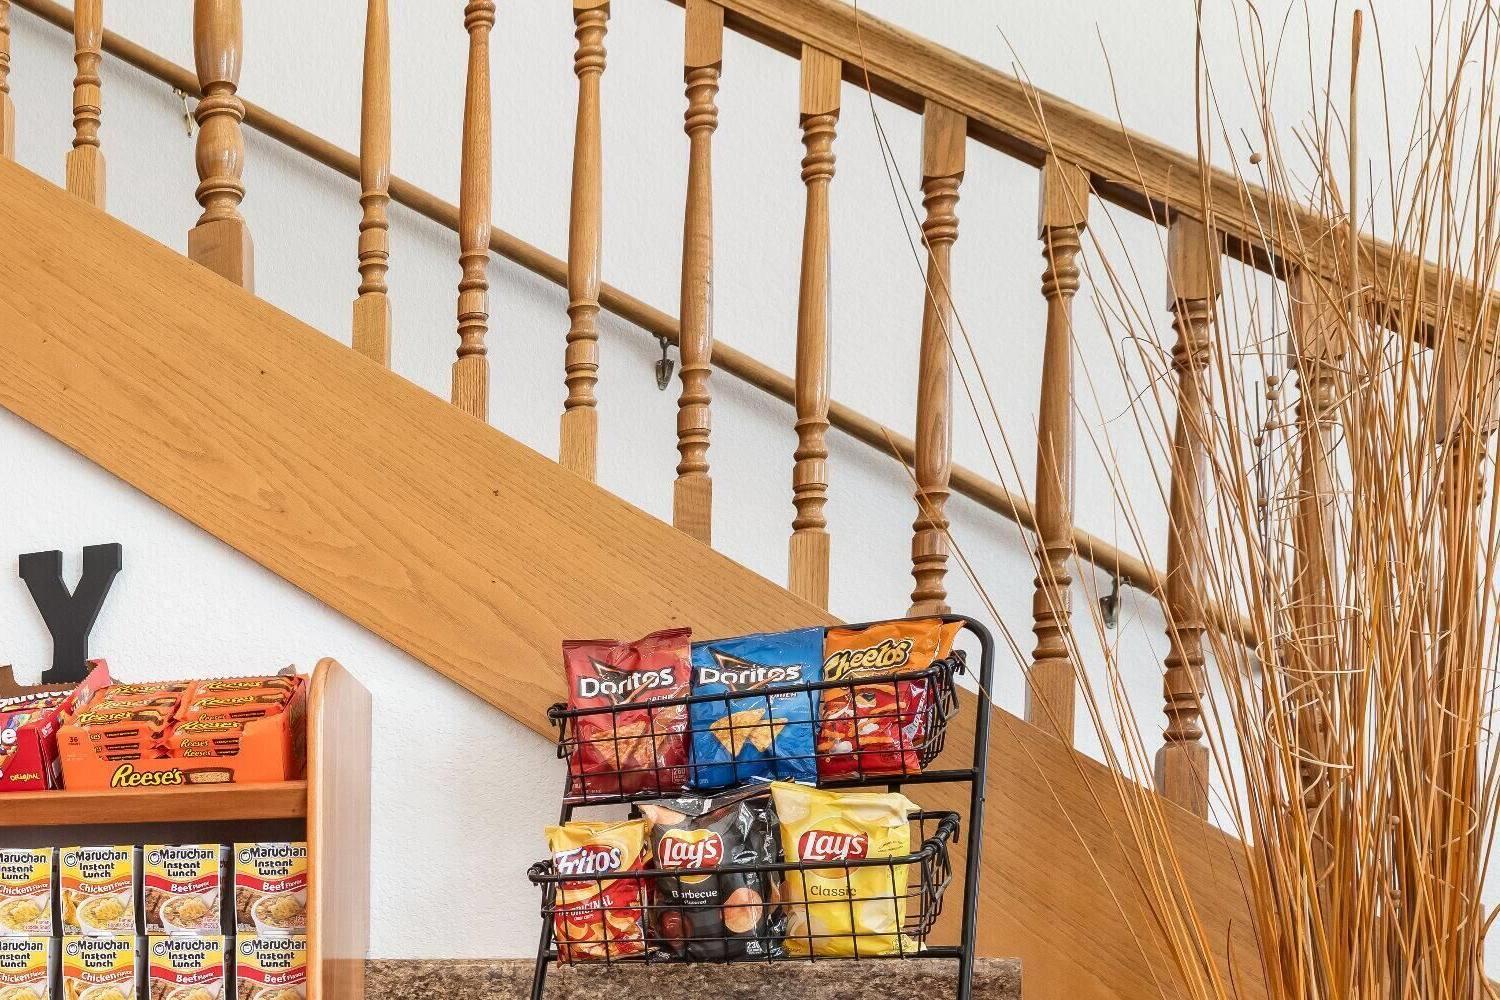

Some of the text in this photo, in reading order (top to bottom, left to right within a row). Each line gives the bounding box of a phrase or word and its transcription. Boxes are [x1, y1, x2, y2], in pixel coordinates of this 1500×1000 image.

[825, 640, 913, 680] Cheetos
[699, 664, 802, 686] Doritos
[579, 667, 676, 698] Doritos
[110, 762, 184, 788] Reese's
[802, 831, 866, 861] Lay's
[75, 851, 128, 862] Maruchan
[160, 849, 214, 860] Maruchan
[250, 847, 307, 858] Maruchan
[662, 837, 719, 868] Lay's
[163, 861, 201, 869] Instant
[254, 858, 293, 868] Instant
[555, 847, 622, 874] Fritos
[79, 862, 115, 871] Instant
[258, 867, 289, 876] Lunch
[1, 872, 30, 880] Lunch
[83, 870, 111, 879] Lunch
[167, 868, 197, 877] Lunch
[78, 882, 114, 894] Chicken
[170, 882, 193, 893] Beef
[262, 881, 286, 891] Beef
[810, 885, 857, 897] Classic
[77, 940, 130, 951] Maruchan
[164, 940, 219, 951] Maruchan
[81, 951, 117, 960] Instant
[168, 951, 206, 960] Instant
[256, 951, 295, 961] Instant
[0, 960, 27, 968] Lunch
[84, 959, 114, 968] Lunch
[172, 960, 201, 968] Lunch
[260, 960, 291, 968] Lunch
[81, 971, 117, 982] Chicken
[175, 973, 198, 983] Beef
[264, 973, 287, 983] Beef
